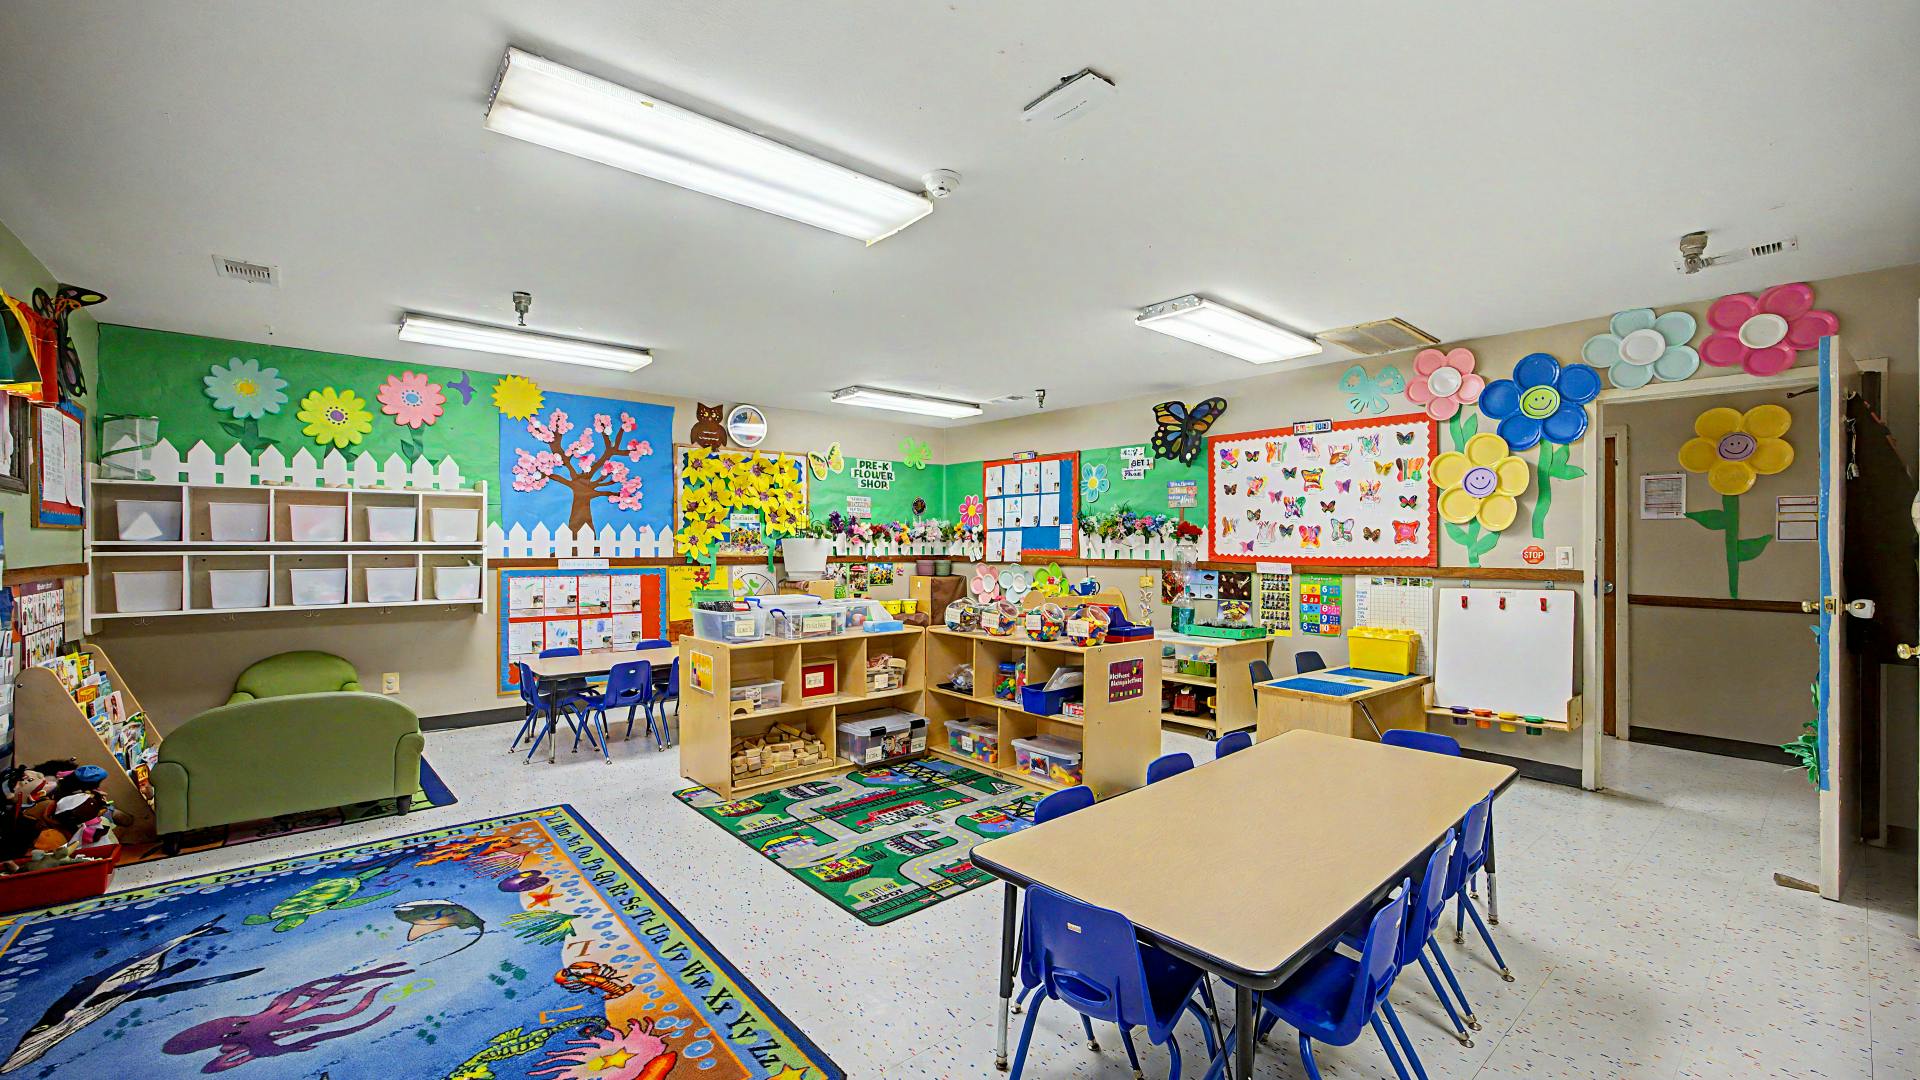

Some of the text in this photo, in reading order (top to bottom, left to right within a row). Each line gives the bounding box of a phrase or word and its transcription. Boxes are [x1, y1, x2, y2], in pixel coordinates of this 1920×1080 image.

[859, 460, 889, 471] PRE-K
[854, 469, 893, 481] FLOWER
[860, 479, 887, 489] SHOP
[1523, 551, 1544, 559] STOP
[1322, 614, 1328, 622] 9
[581, 857, 605, 871] Pp
[606, 881, 630, 897] Rr
[618, 896, 642, 911] Ss
[631, 908, 656, 926] Tt
[644, 923, 671, 945] Uu
[661, 941, 689, 962] Vv
[679, 960, 713, 989] Ww
[701, 986, 734, 1016] Xx
[726, 1011, 758, 1040] Yy
[747, 1038, 782, 1068] Zz
